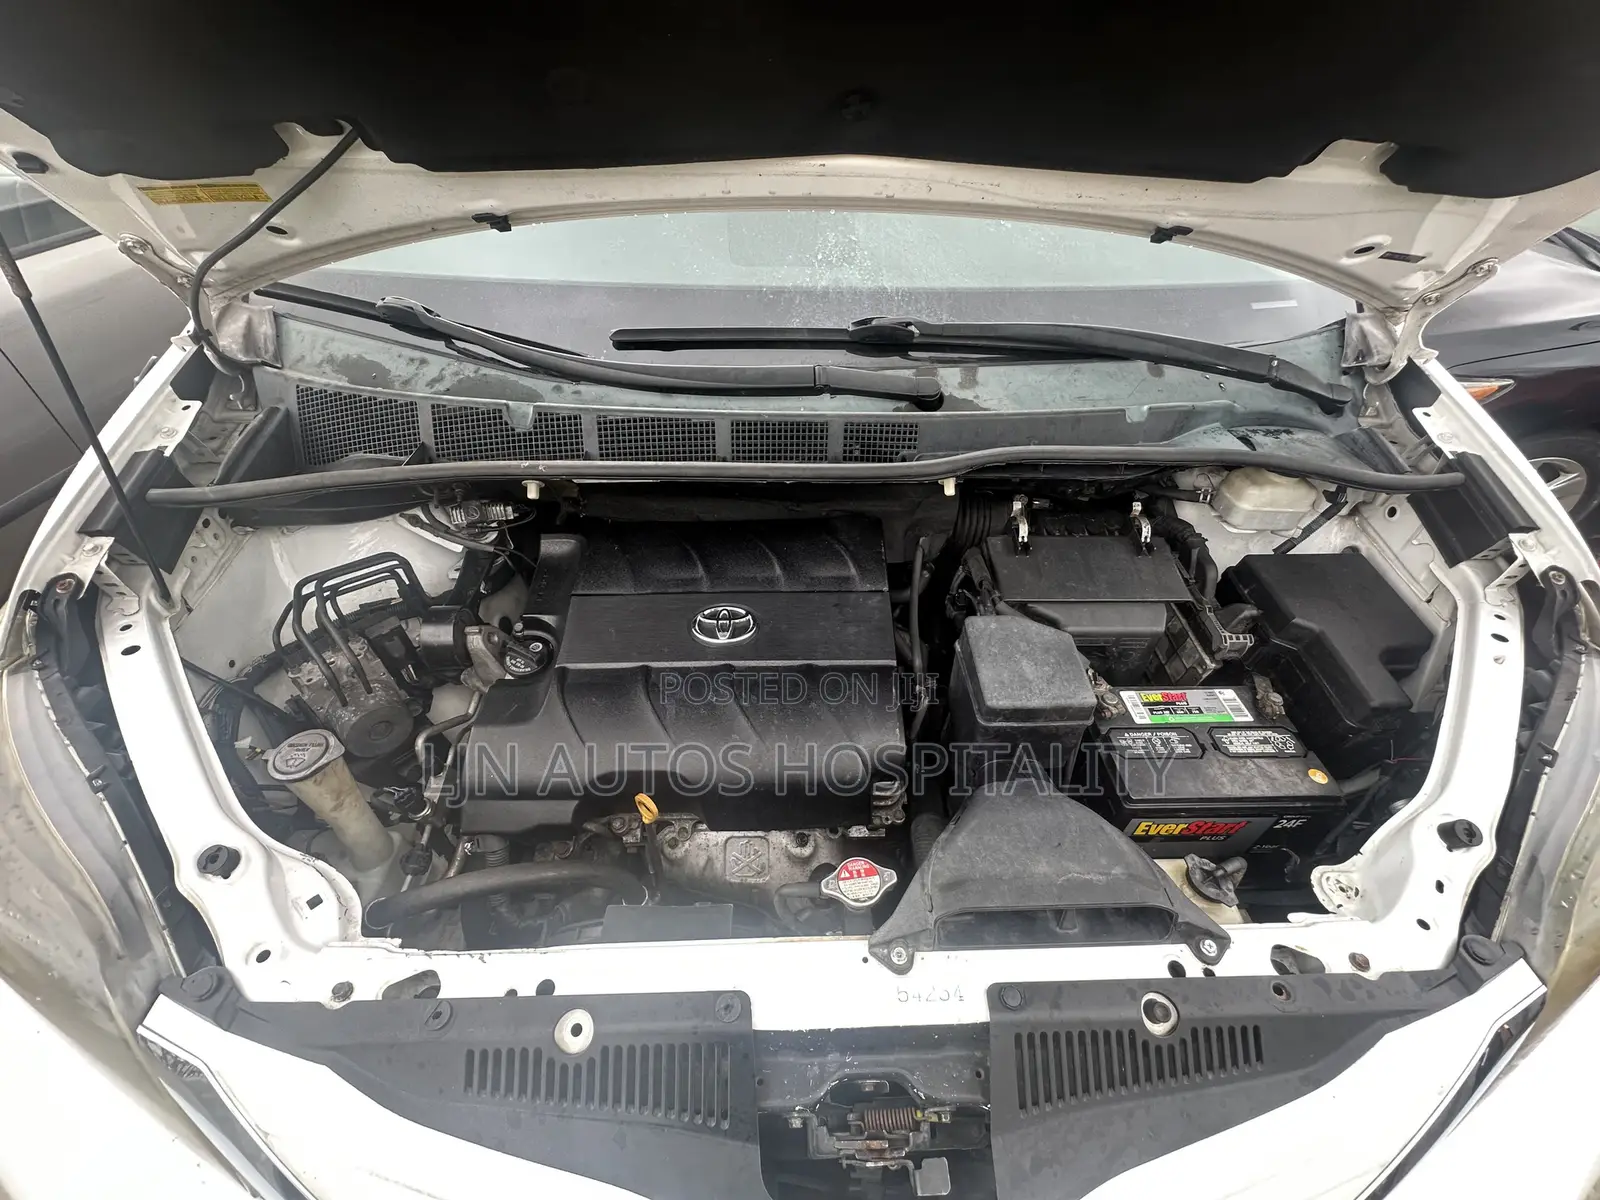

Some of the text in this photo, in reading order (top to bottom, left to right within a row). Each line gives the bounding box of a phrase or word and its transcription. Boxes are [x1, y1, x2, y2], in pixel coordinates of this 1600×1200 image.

[1140, 691, 1187, 703] EverStart
[1134, 820, 1249, 836] EverStart
[1273, 818, 1308, 829] 24F
